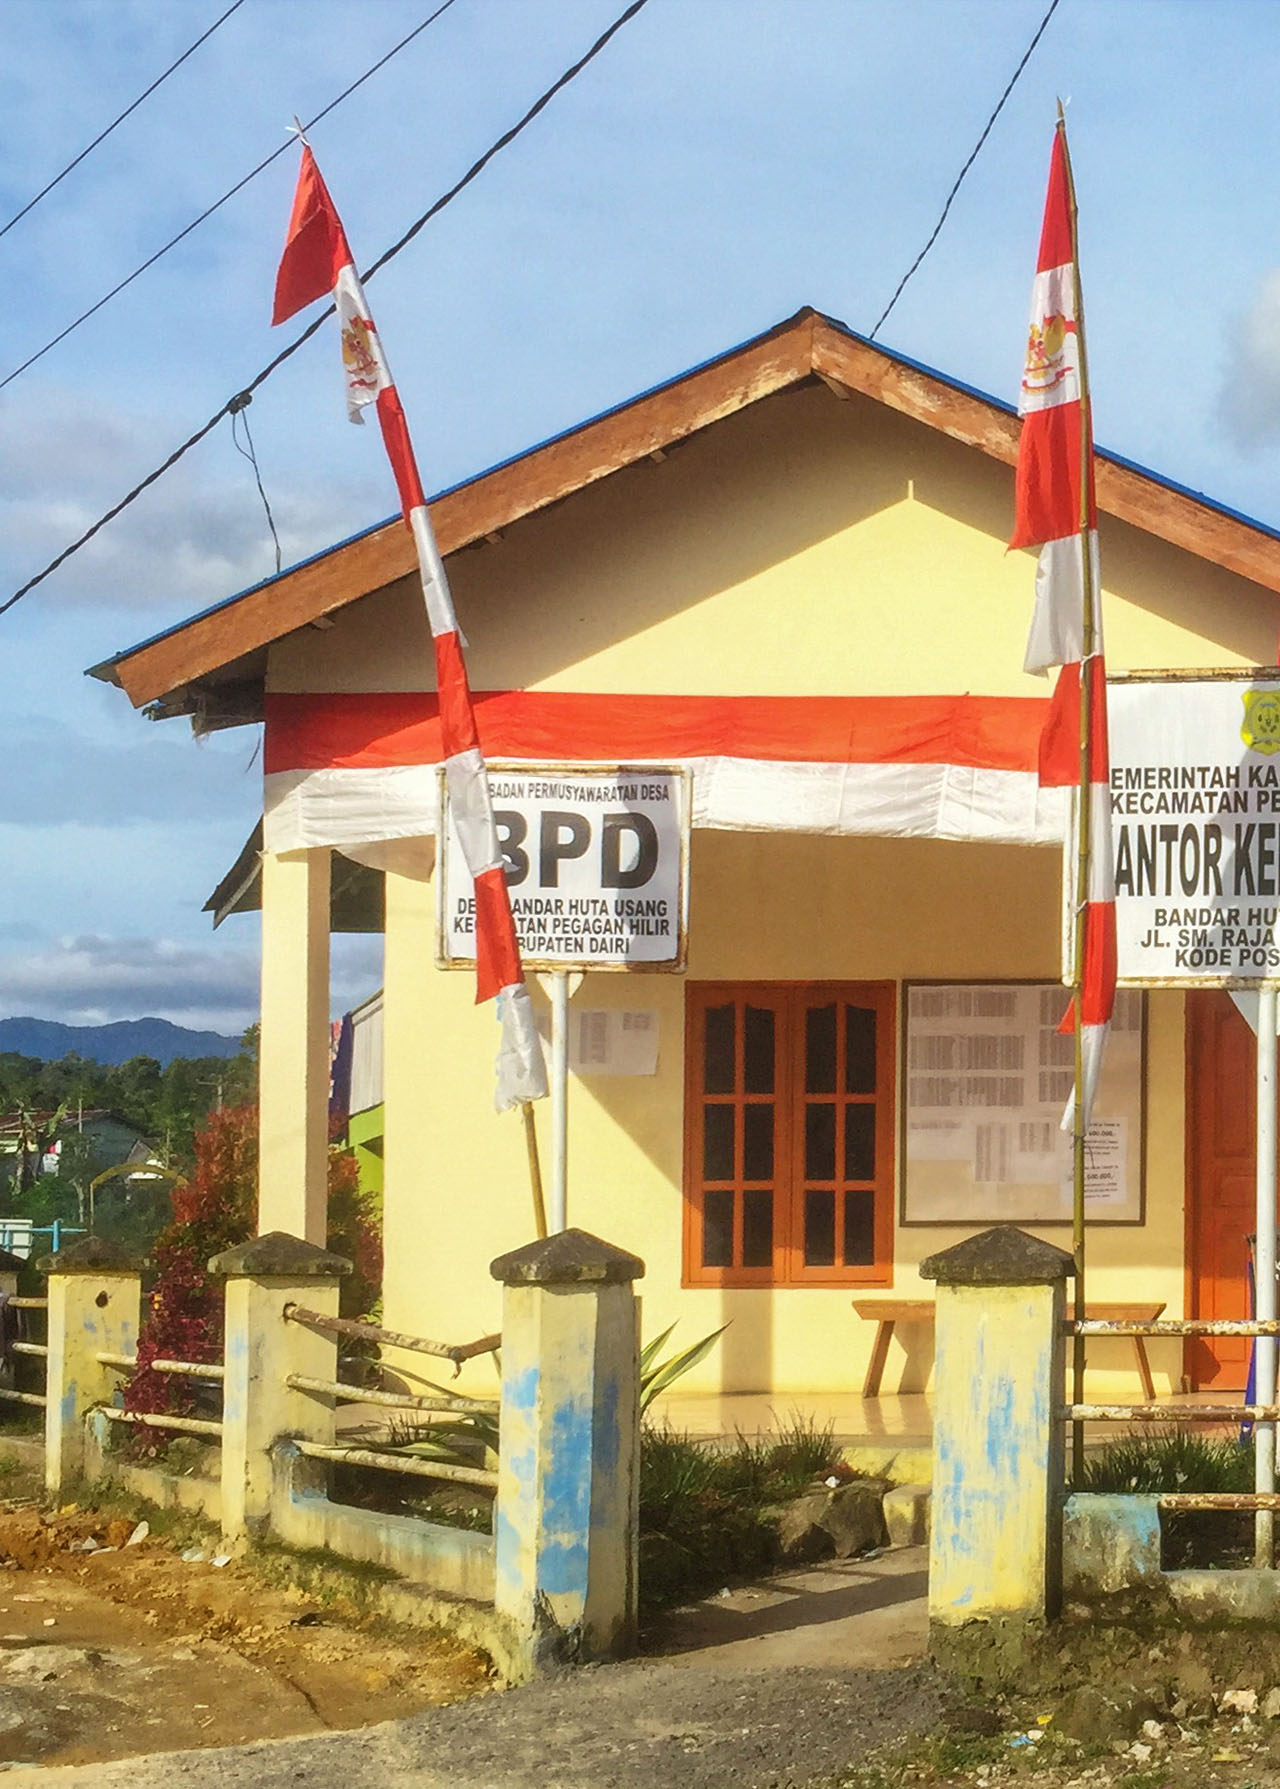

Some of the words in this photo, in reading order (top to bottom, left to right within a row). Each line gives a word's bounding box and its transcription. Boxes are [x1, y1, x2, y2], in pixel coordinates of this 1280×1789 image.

[1111, 766, 1240, 790] EMERINTAH
[528, 783, 638, 802] PERMUSYAWARATAN
[641, 784, 669, 800] DESA
[1110, 791, 1249, 815] KECAMATAN
[493, 810, 659, 889] BPD
[1115, 823, 1223, 897] ANTOR
[513, 898, 563, 917] ANDAR
[569, 899, 609, 916] HUTA
[614, 900, 668, 918] USANG
[1154, 907, 1240, 927] BANDAR
[553, 917, 624, 936] PEGAGAN
[629, 919, 670, 937] HILIR
[518, 937, 584, 954] BUPATEN
[589, 937, 631, 954] DAIRI
[1140, 929, 1171, 949] JL.
[1178, 929, 1214, 948] SM.
[1221, 928, 1276, 948] RAJA
[1175, 949, 1232, 968] KODE
[1239, 949, 1280, 967] POS
